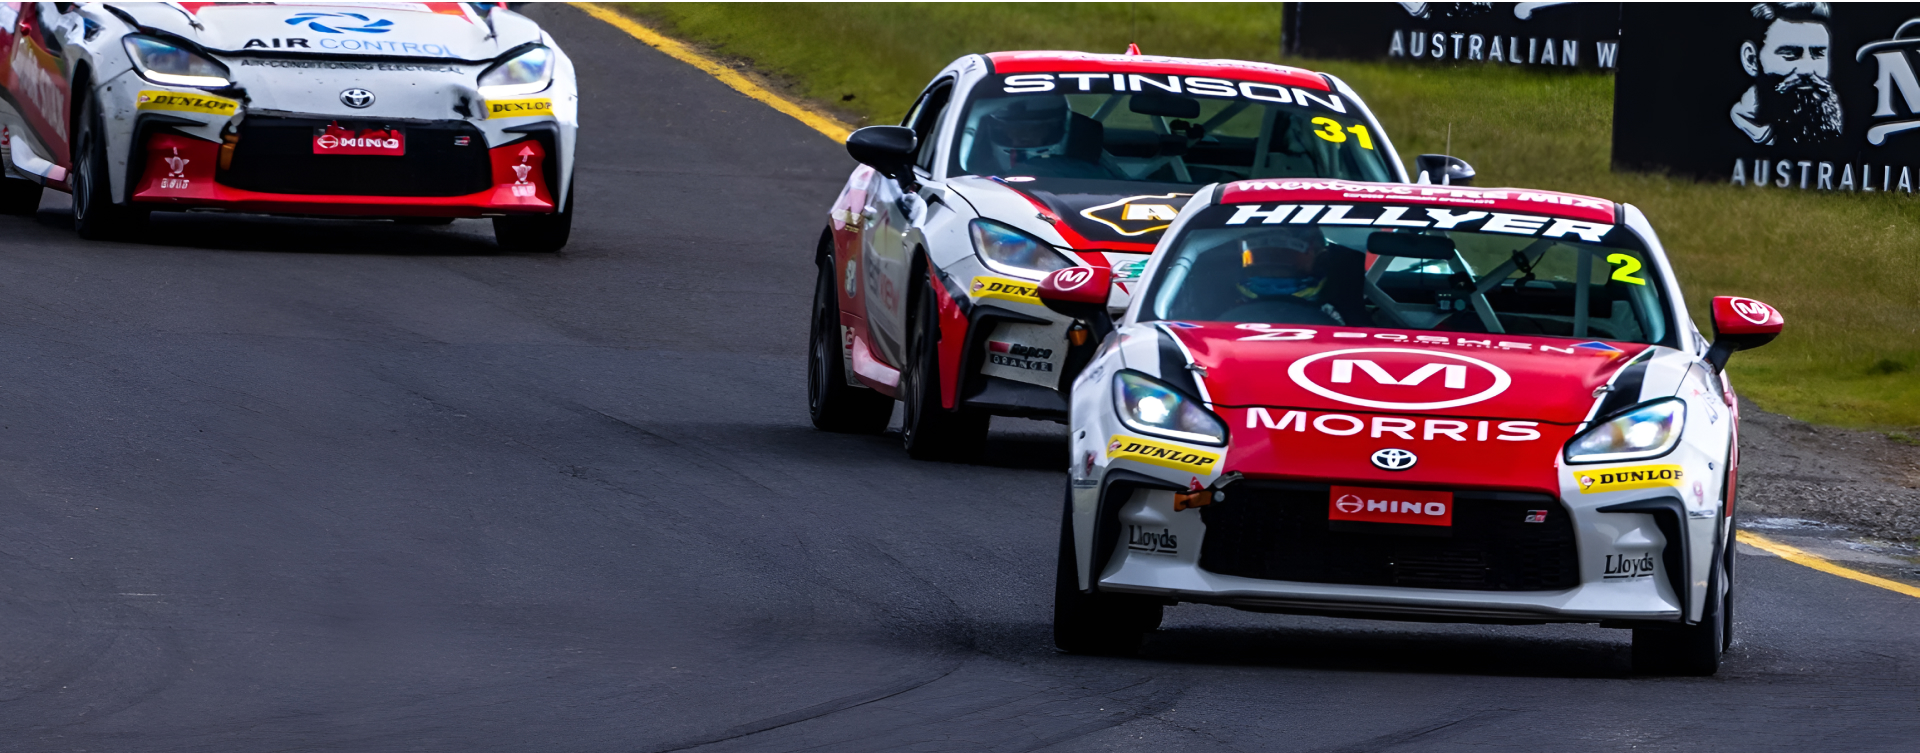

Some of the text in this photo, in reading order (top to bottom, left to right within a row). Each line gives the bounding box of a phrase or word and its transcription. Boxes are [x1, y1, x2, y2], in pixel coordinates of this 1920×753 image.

[243, 38, 461, 57] AIR CONTROL
[1389, 30, 1578, 66] AUSTRALIAN
[153, 95, 235, 110] DUNLOP
[1003, 73, 1347, 114] STINSON
[340, 137, 399, 149] HINO
[1311, 116, 1374, 150] 31
[1730, 158, 1920, 193] AUSTRALIA
[1225, 203, 1616, 243] HILLYER
[1060, 270, 1088, 283] M
[1606, 253, 1646, 286] 2
[1735, 302, 1766, 315] M
[993, 355, 1049, 371] ORANGE
[1330, 358, 1466, 390] M
[1246, 406, 1541, 442] MORRIS
[1122, 442, 1215, 467] DUNLOP
[1599, 469, 1684, 485] DUNLOP
[1366, 498, 1446, 516] HINO
[1128, 524, 1178, 552] Lloyds
[1604, 552, 1654, 577] Lloyds
